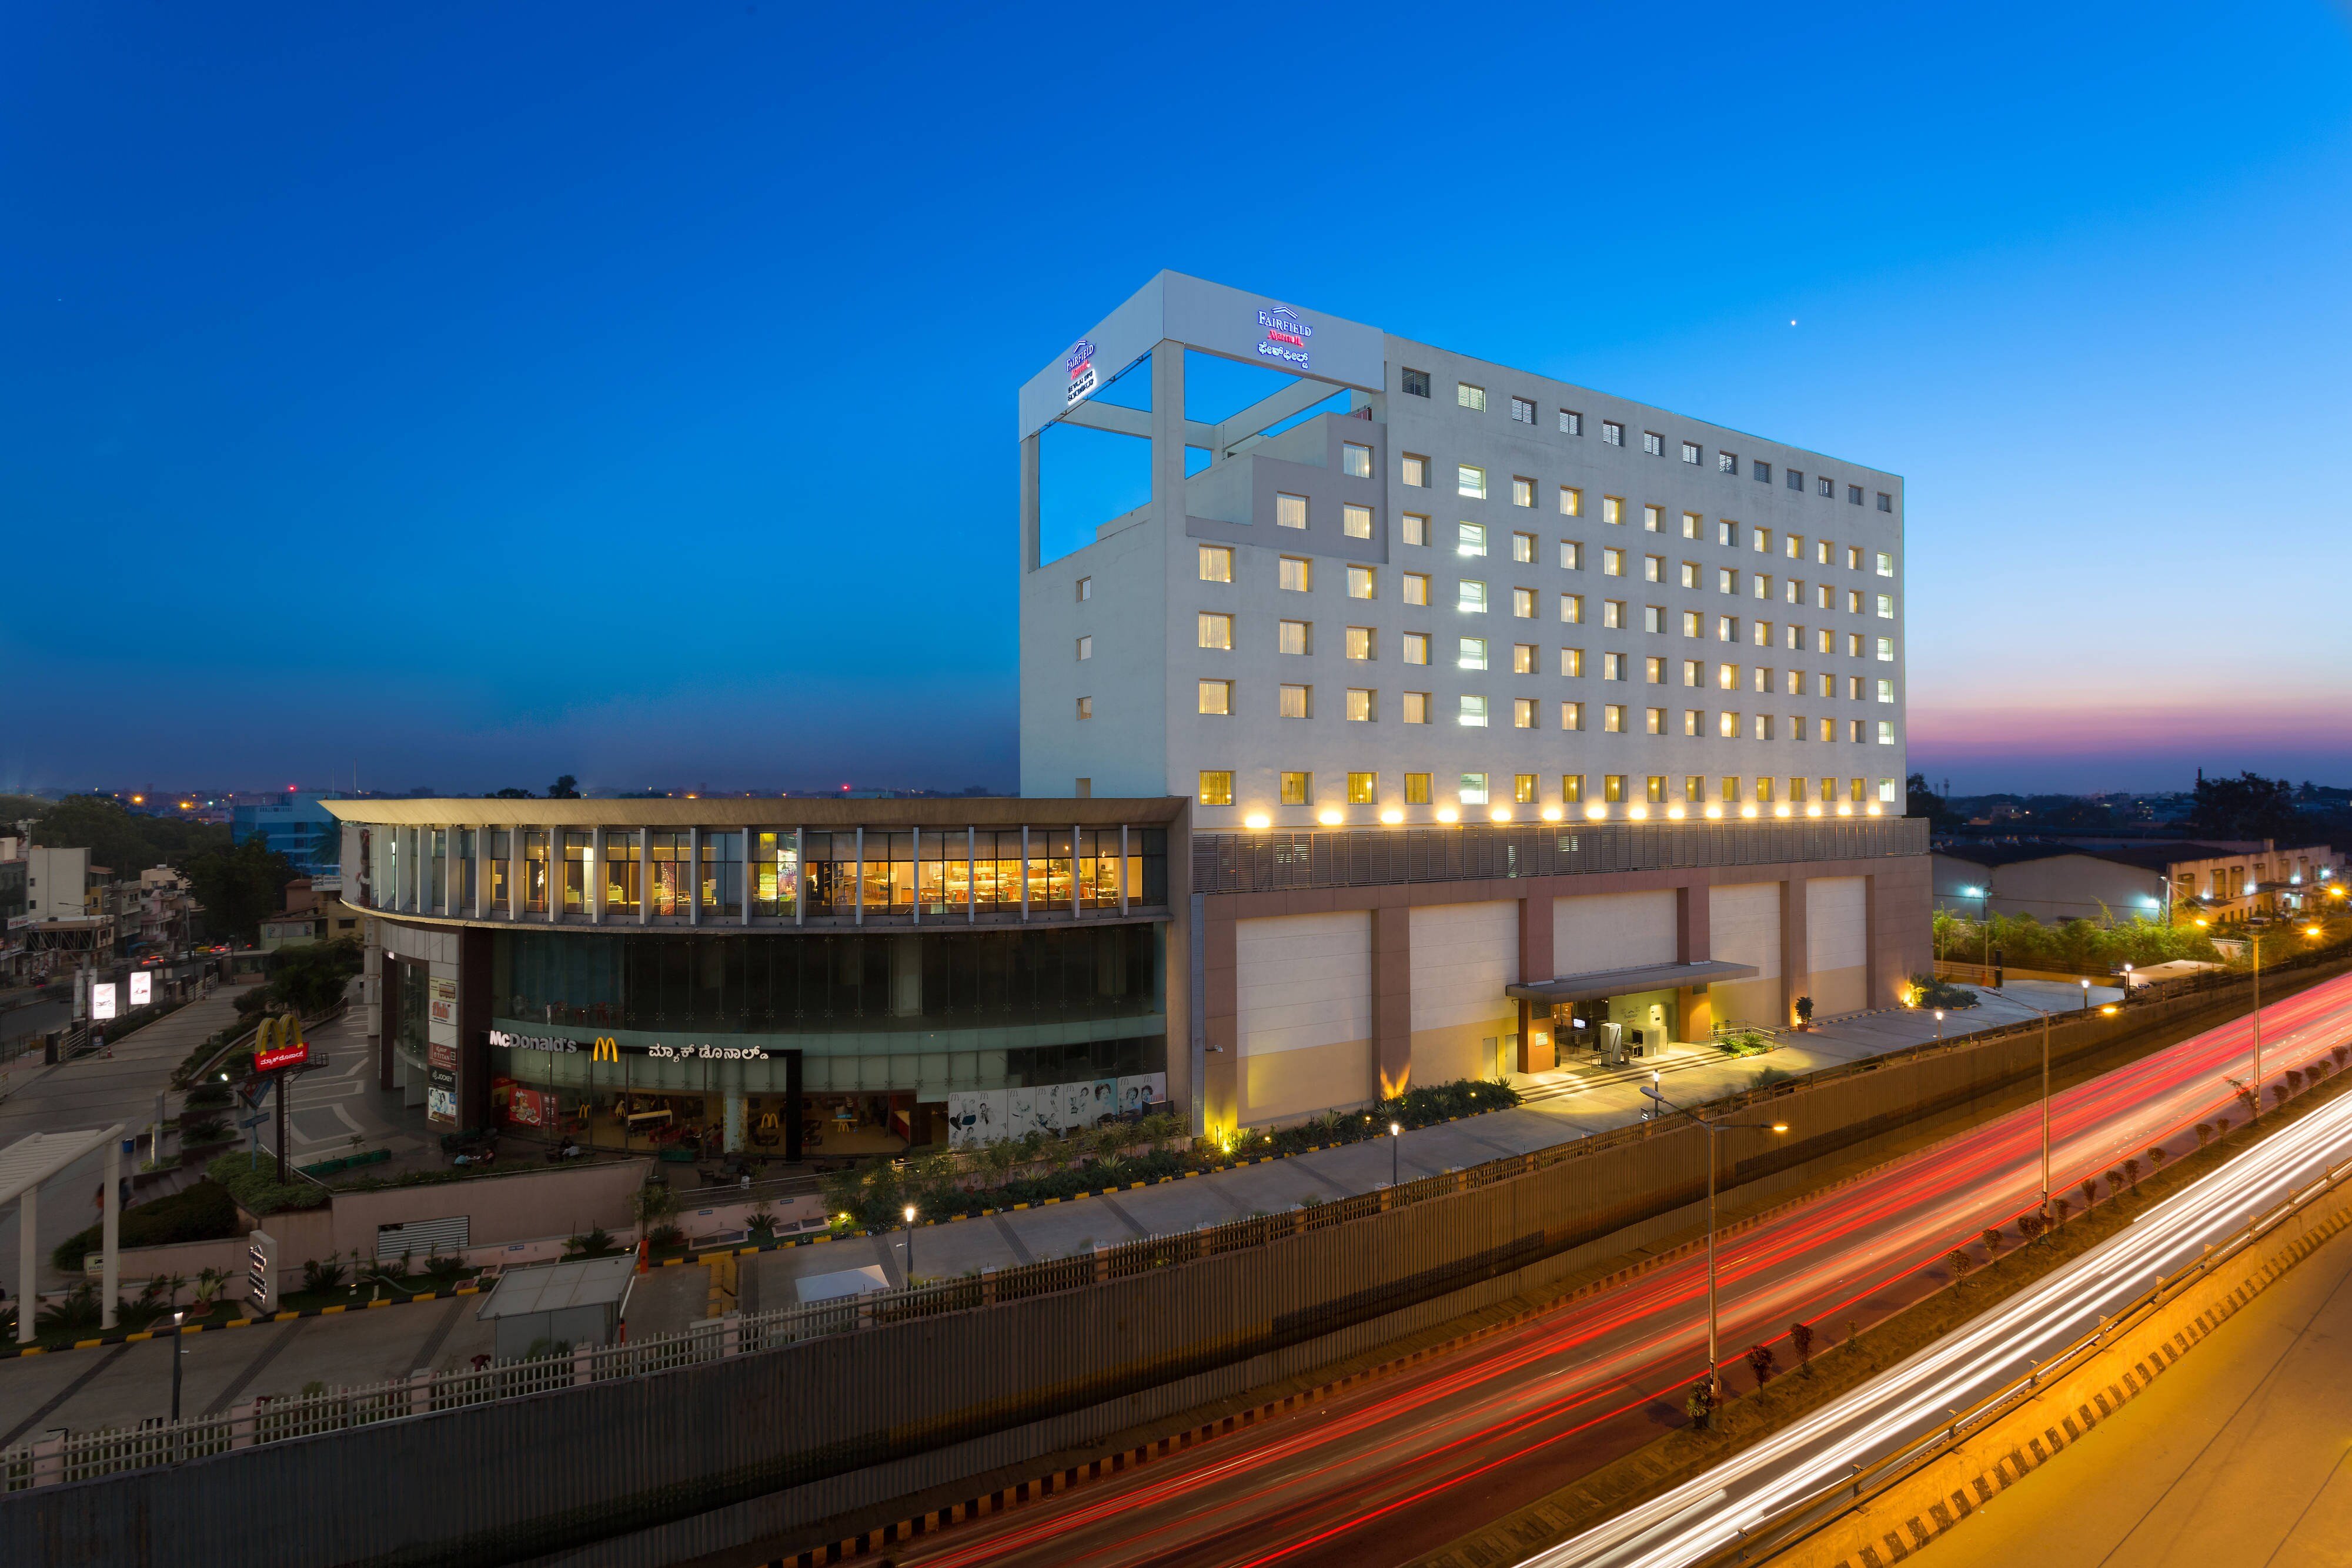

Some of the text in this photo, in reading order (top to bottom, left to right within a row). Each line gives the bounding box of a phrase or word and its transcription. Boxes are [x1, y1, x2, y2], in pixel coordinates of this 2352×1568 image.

[1258, 310, 1312, 337] FAIRFIELD
[1066, 344, 1094, 372] FAIRFIELD
[490, 1030, 577, 1054] McDonald's
[437, 1073, 453, 1082] JOCKEY
